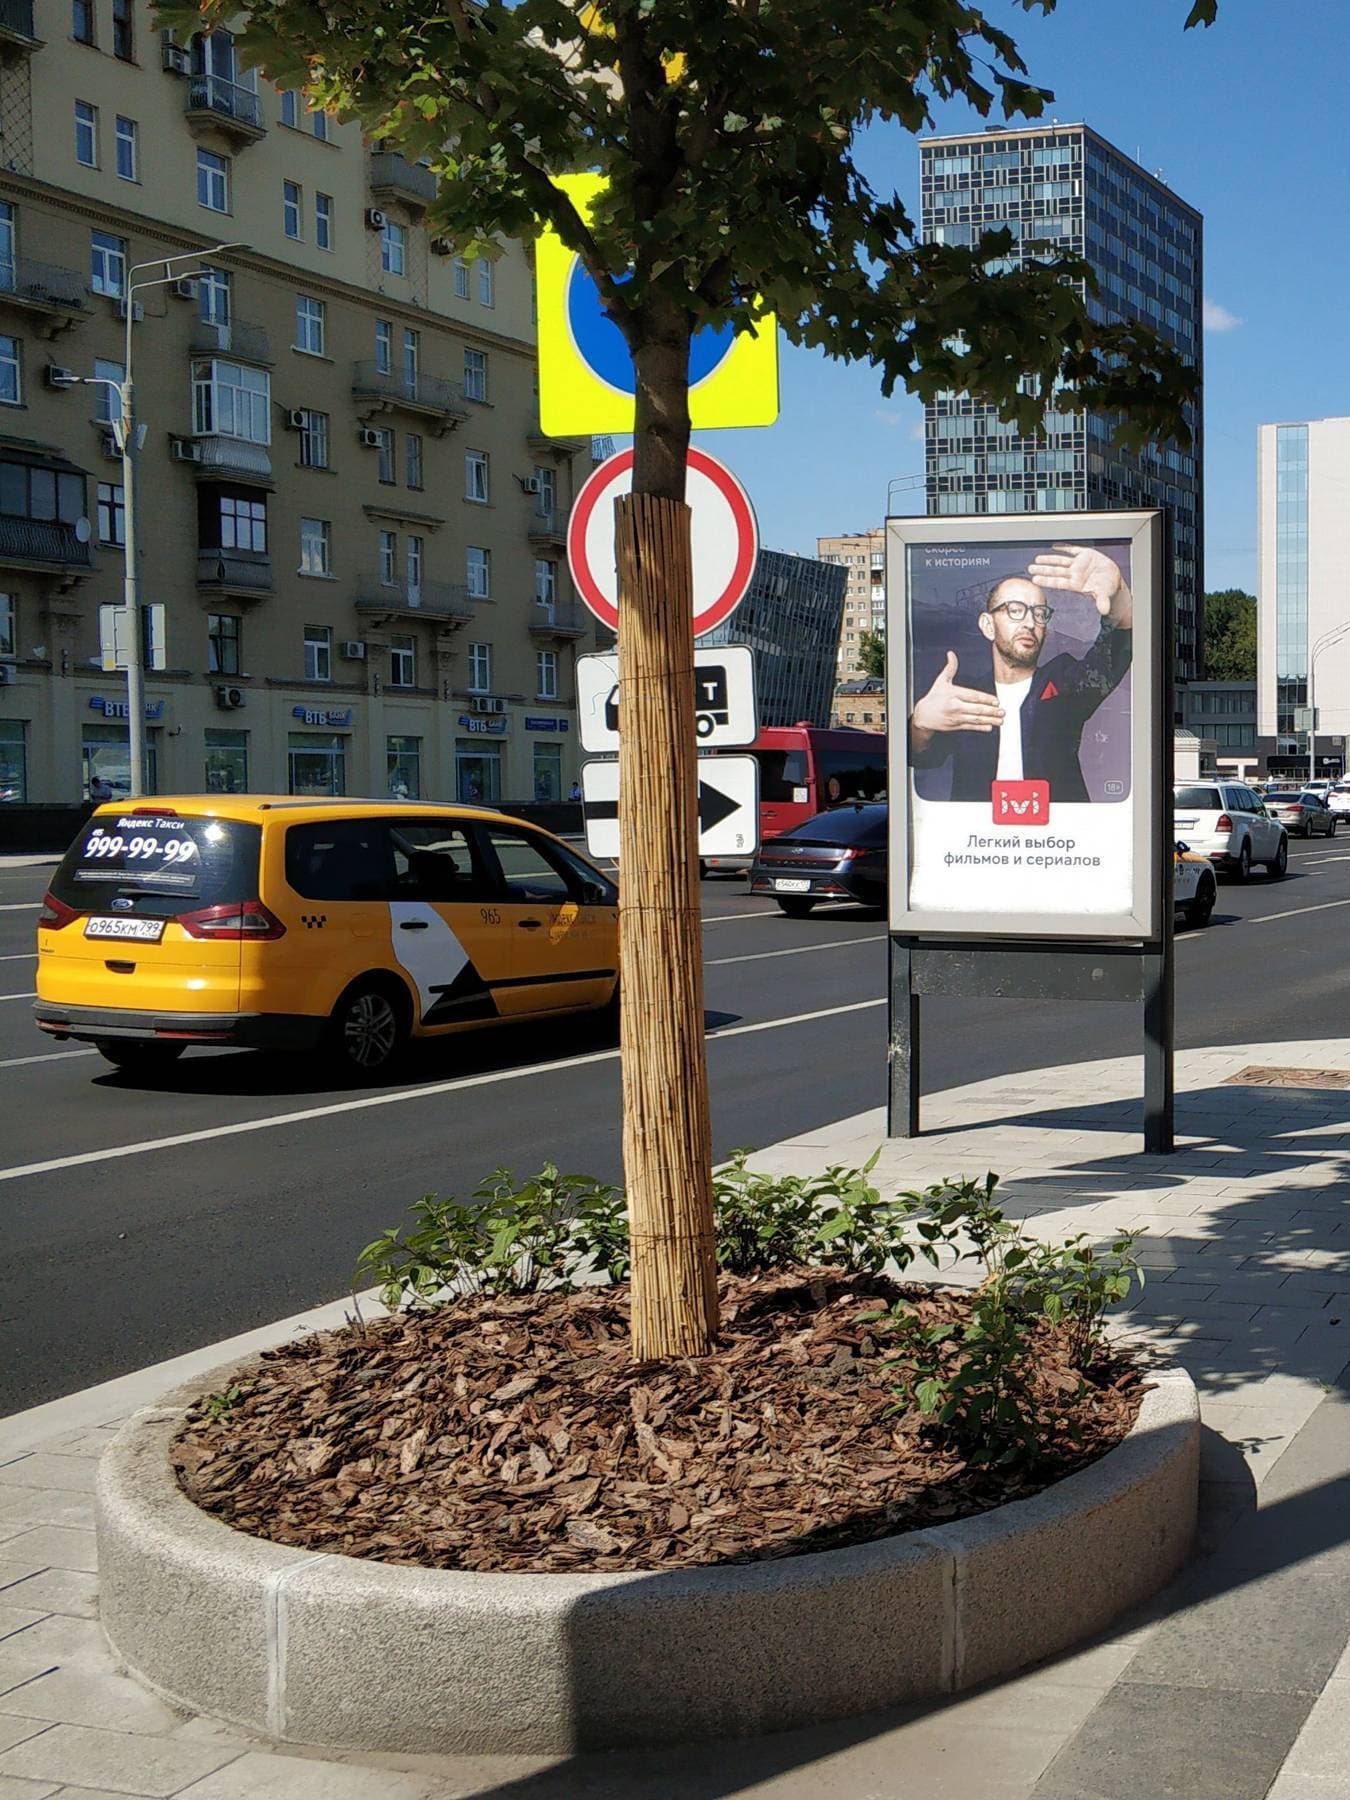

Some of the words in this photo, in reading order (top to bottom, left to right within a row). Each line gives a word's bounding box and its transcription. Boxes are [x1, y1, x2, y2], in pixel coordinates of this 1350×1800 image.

[934, 557, 991, 568] историям
[305, 710, 327, 725] ВТБ
[469, 719, 487, 732] ВТБ
[1001, 791, 1040, 815] ivi
[117, 818, 154, 829] Яндекс
[155, 818, 184, 829] Такси
[84, 836, 195, 862] 999-99-99
[967, 835, 1020, 848] Легкий
[1025, 836, 1076, 852] выбор
[943, 852, 1009, 867] фильмов
[1013, 856, 1022, 865] и
[1026, 856, 1101, 869] сериалов
[480, 908, 501, 925] 965
[140, 921, 160, 933] 799
